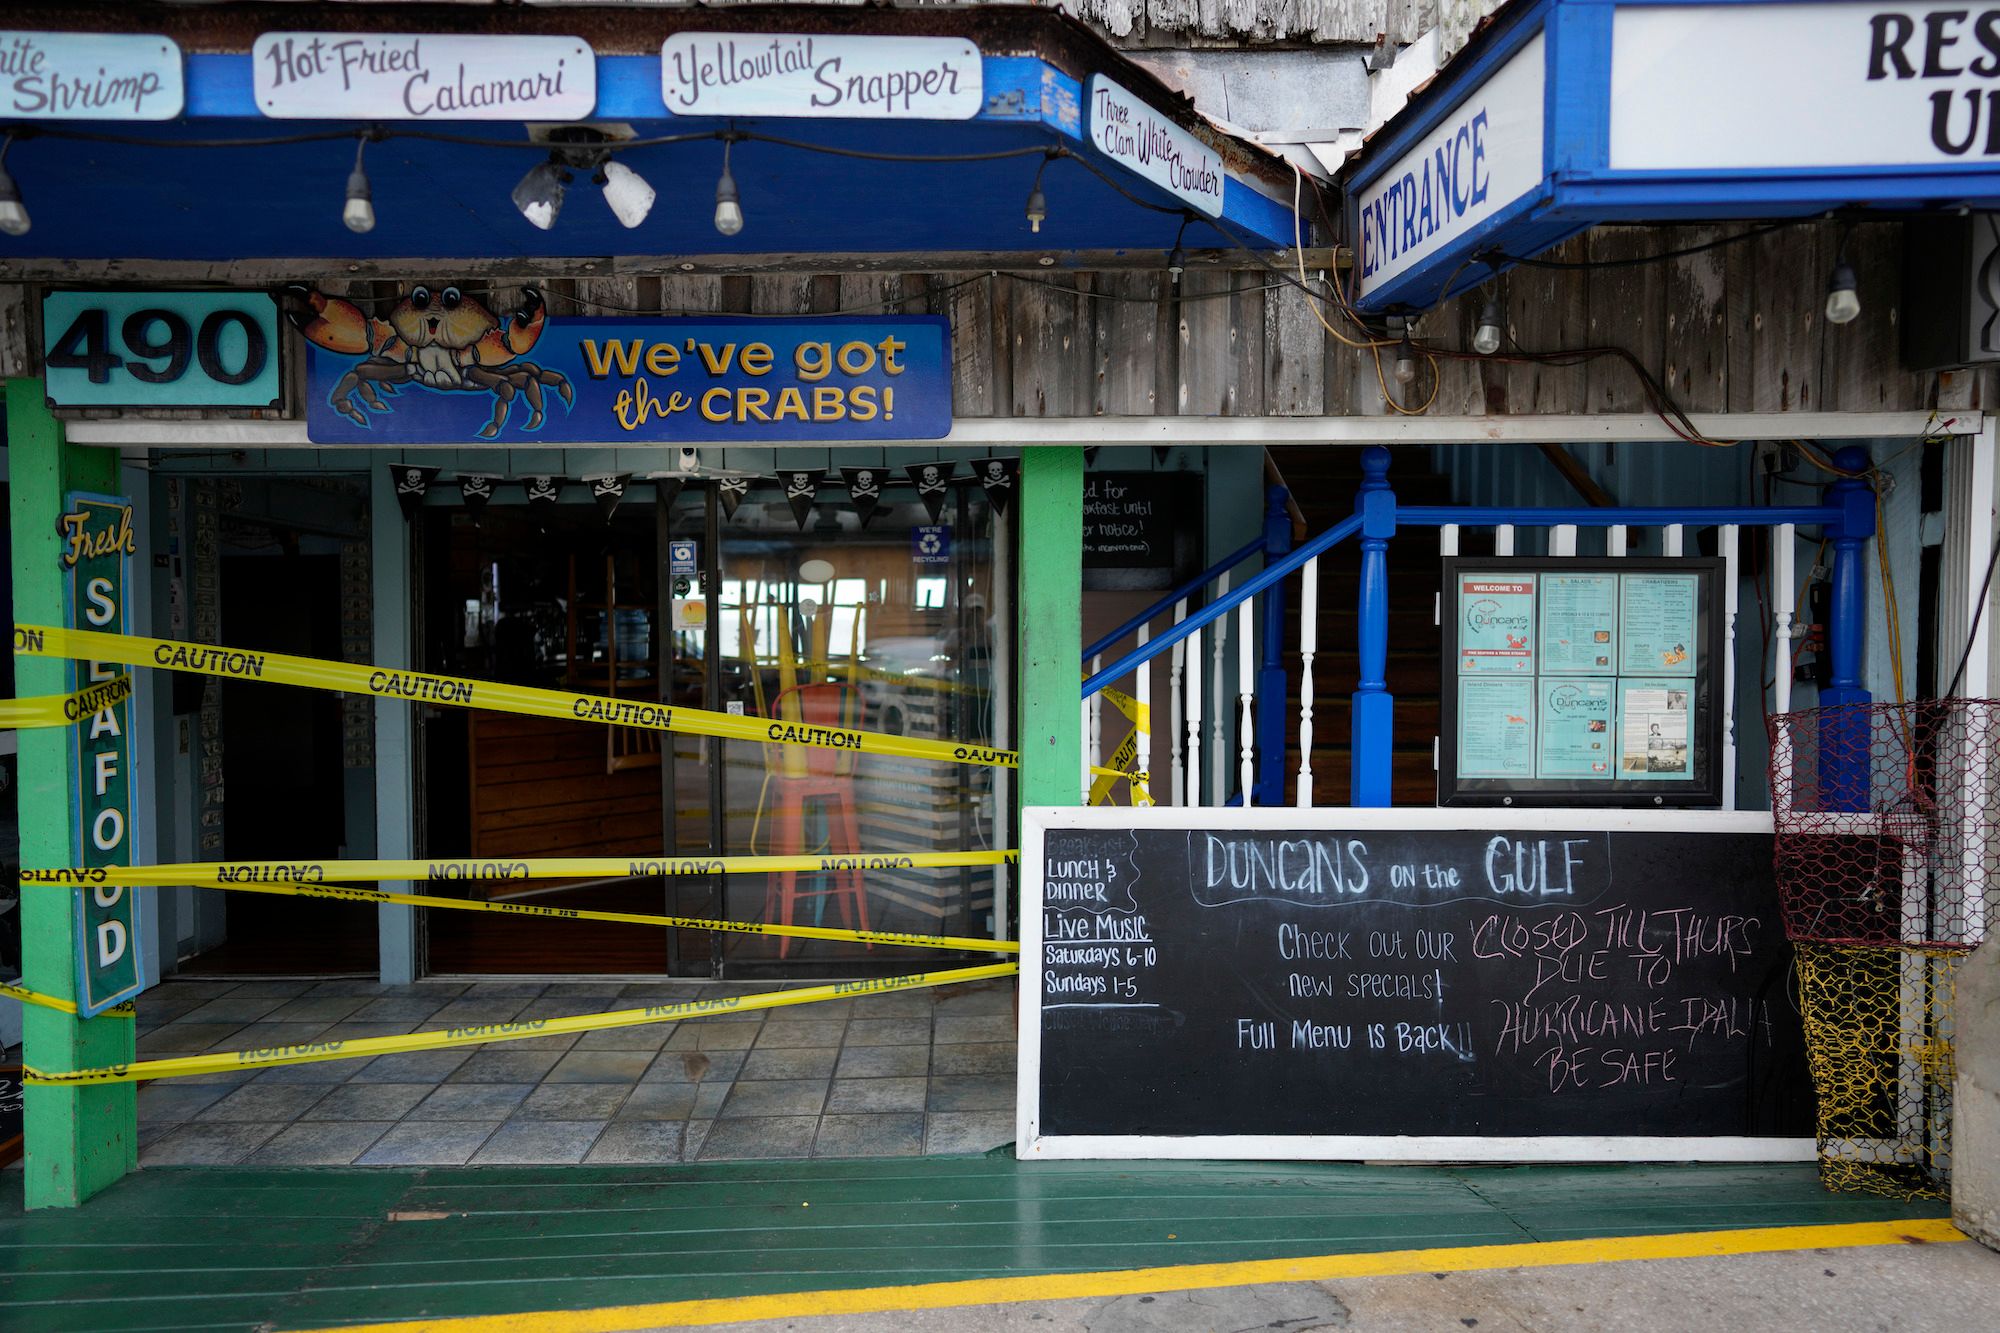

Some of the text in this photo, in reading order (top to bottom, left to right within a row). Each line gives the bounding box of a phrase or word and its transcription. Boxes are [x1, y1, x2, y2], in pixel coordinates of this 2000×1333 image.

[266, 38, 421, 91] Hot-Fried
[404, 60, 565, 116] Calamari
[671, 38, 816, 106] Yellowtail
[810, 58, 961, 113] Snapper
[13, 67, 164, 113] Shrimp
[1096, 88, 1129, 124] Three
[1105, 115, 1173, 166] Clam White
[1170, 151, 1220, 197] Chowder
[1362, 106, 1490, 279] ENTRANCE
[46, 308, 268, 385] 490
[581, 335, 907, 382] We've got
[612, 376, 894, 431] the CRABS!
[1104, 480, 1128, 499] for
[1124, 501, 1152, 516] until
[62, 505, 137, 566] Fresh
[1099, 520, 1144, 537] notice!
[64, 676, 131, 721] CAUTION
[154, 644, 265, 676] CAUTION
[369, 671, 473, 703] CAUTION
[573, 698, 672, 728] CAUTION
[768, 723, 862, 749] CAUTION
[217, 864, 325, 884] CAUTION
[428, 862, 530, 880] CAUTION
[630, 860, 726, 877] CAUTION
[1424, 864, 1461, 888] the
[1485, 835, 1590, 895] GULF
[1044, 913, 1090, 939] Live
[1278, 923, 1352, 960] Check
[1416, 928, 1458, 963] OUR
[1472, 903, 1761, 973] CLOSED TILL THURS
[1126, 946, 1157, 966] 6-10
[1522, 951, 1671, 1006] DUE TO
[1045, 970, 1138, 998] Sundays 1-5
[1238, 1018, 1276, 1049] Full
[1291, 1018, 1351, 1049] Menu
[1490, 995, 1773, 1056] HURRICANE IDALIA
[1533, 1046, 1677, 1094] BE SAFE
